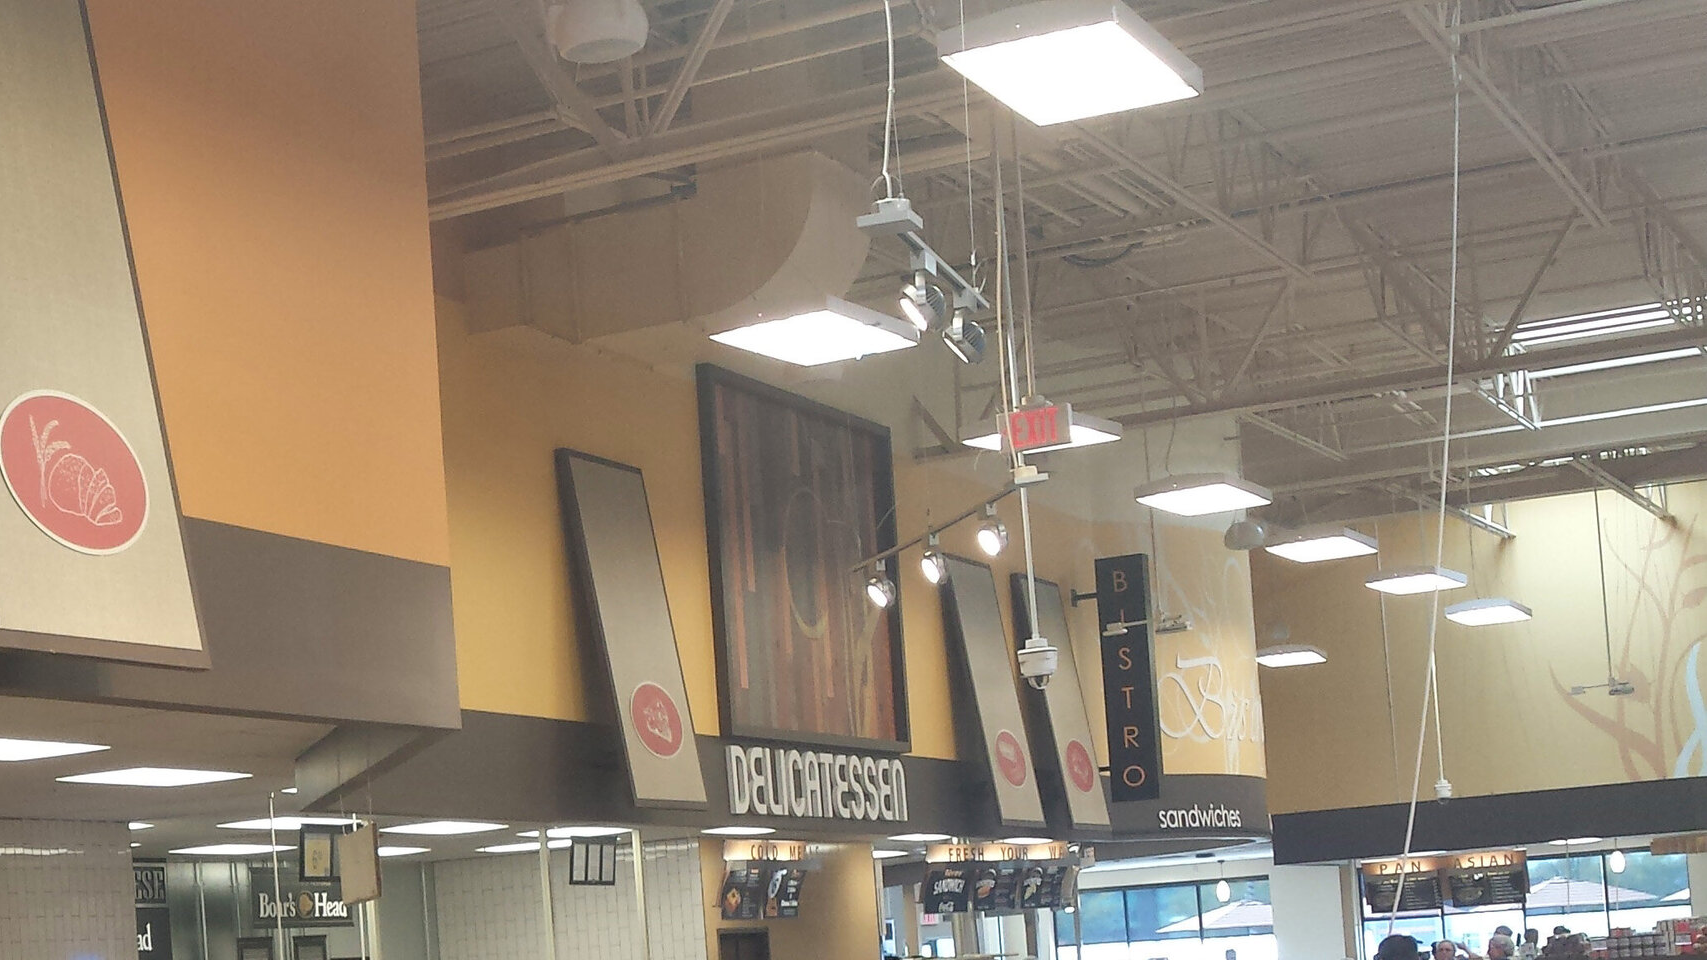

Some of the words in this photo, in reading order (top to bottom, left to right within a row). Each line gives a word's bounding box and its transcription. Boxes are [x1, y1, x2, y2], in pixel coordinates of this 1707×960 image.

[1010, 406, 1058, 448] EXIT
[1112, 570, 1146, 788] BISTRO
[725, 744, 909, 822] DELICATESSEN
[1158, 803, 1242, 829] sandwiches
[948, 847, 984, 863] FRESH
[1000, 846, 1028, 861] YOUR
[1379, 860, 1421, 875] PAN
[1454, 853, 1515, 869] ASIAN
[136, 923, 153, 952] ad
